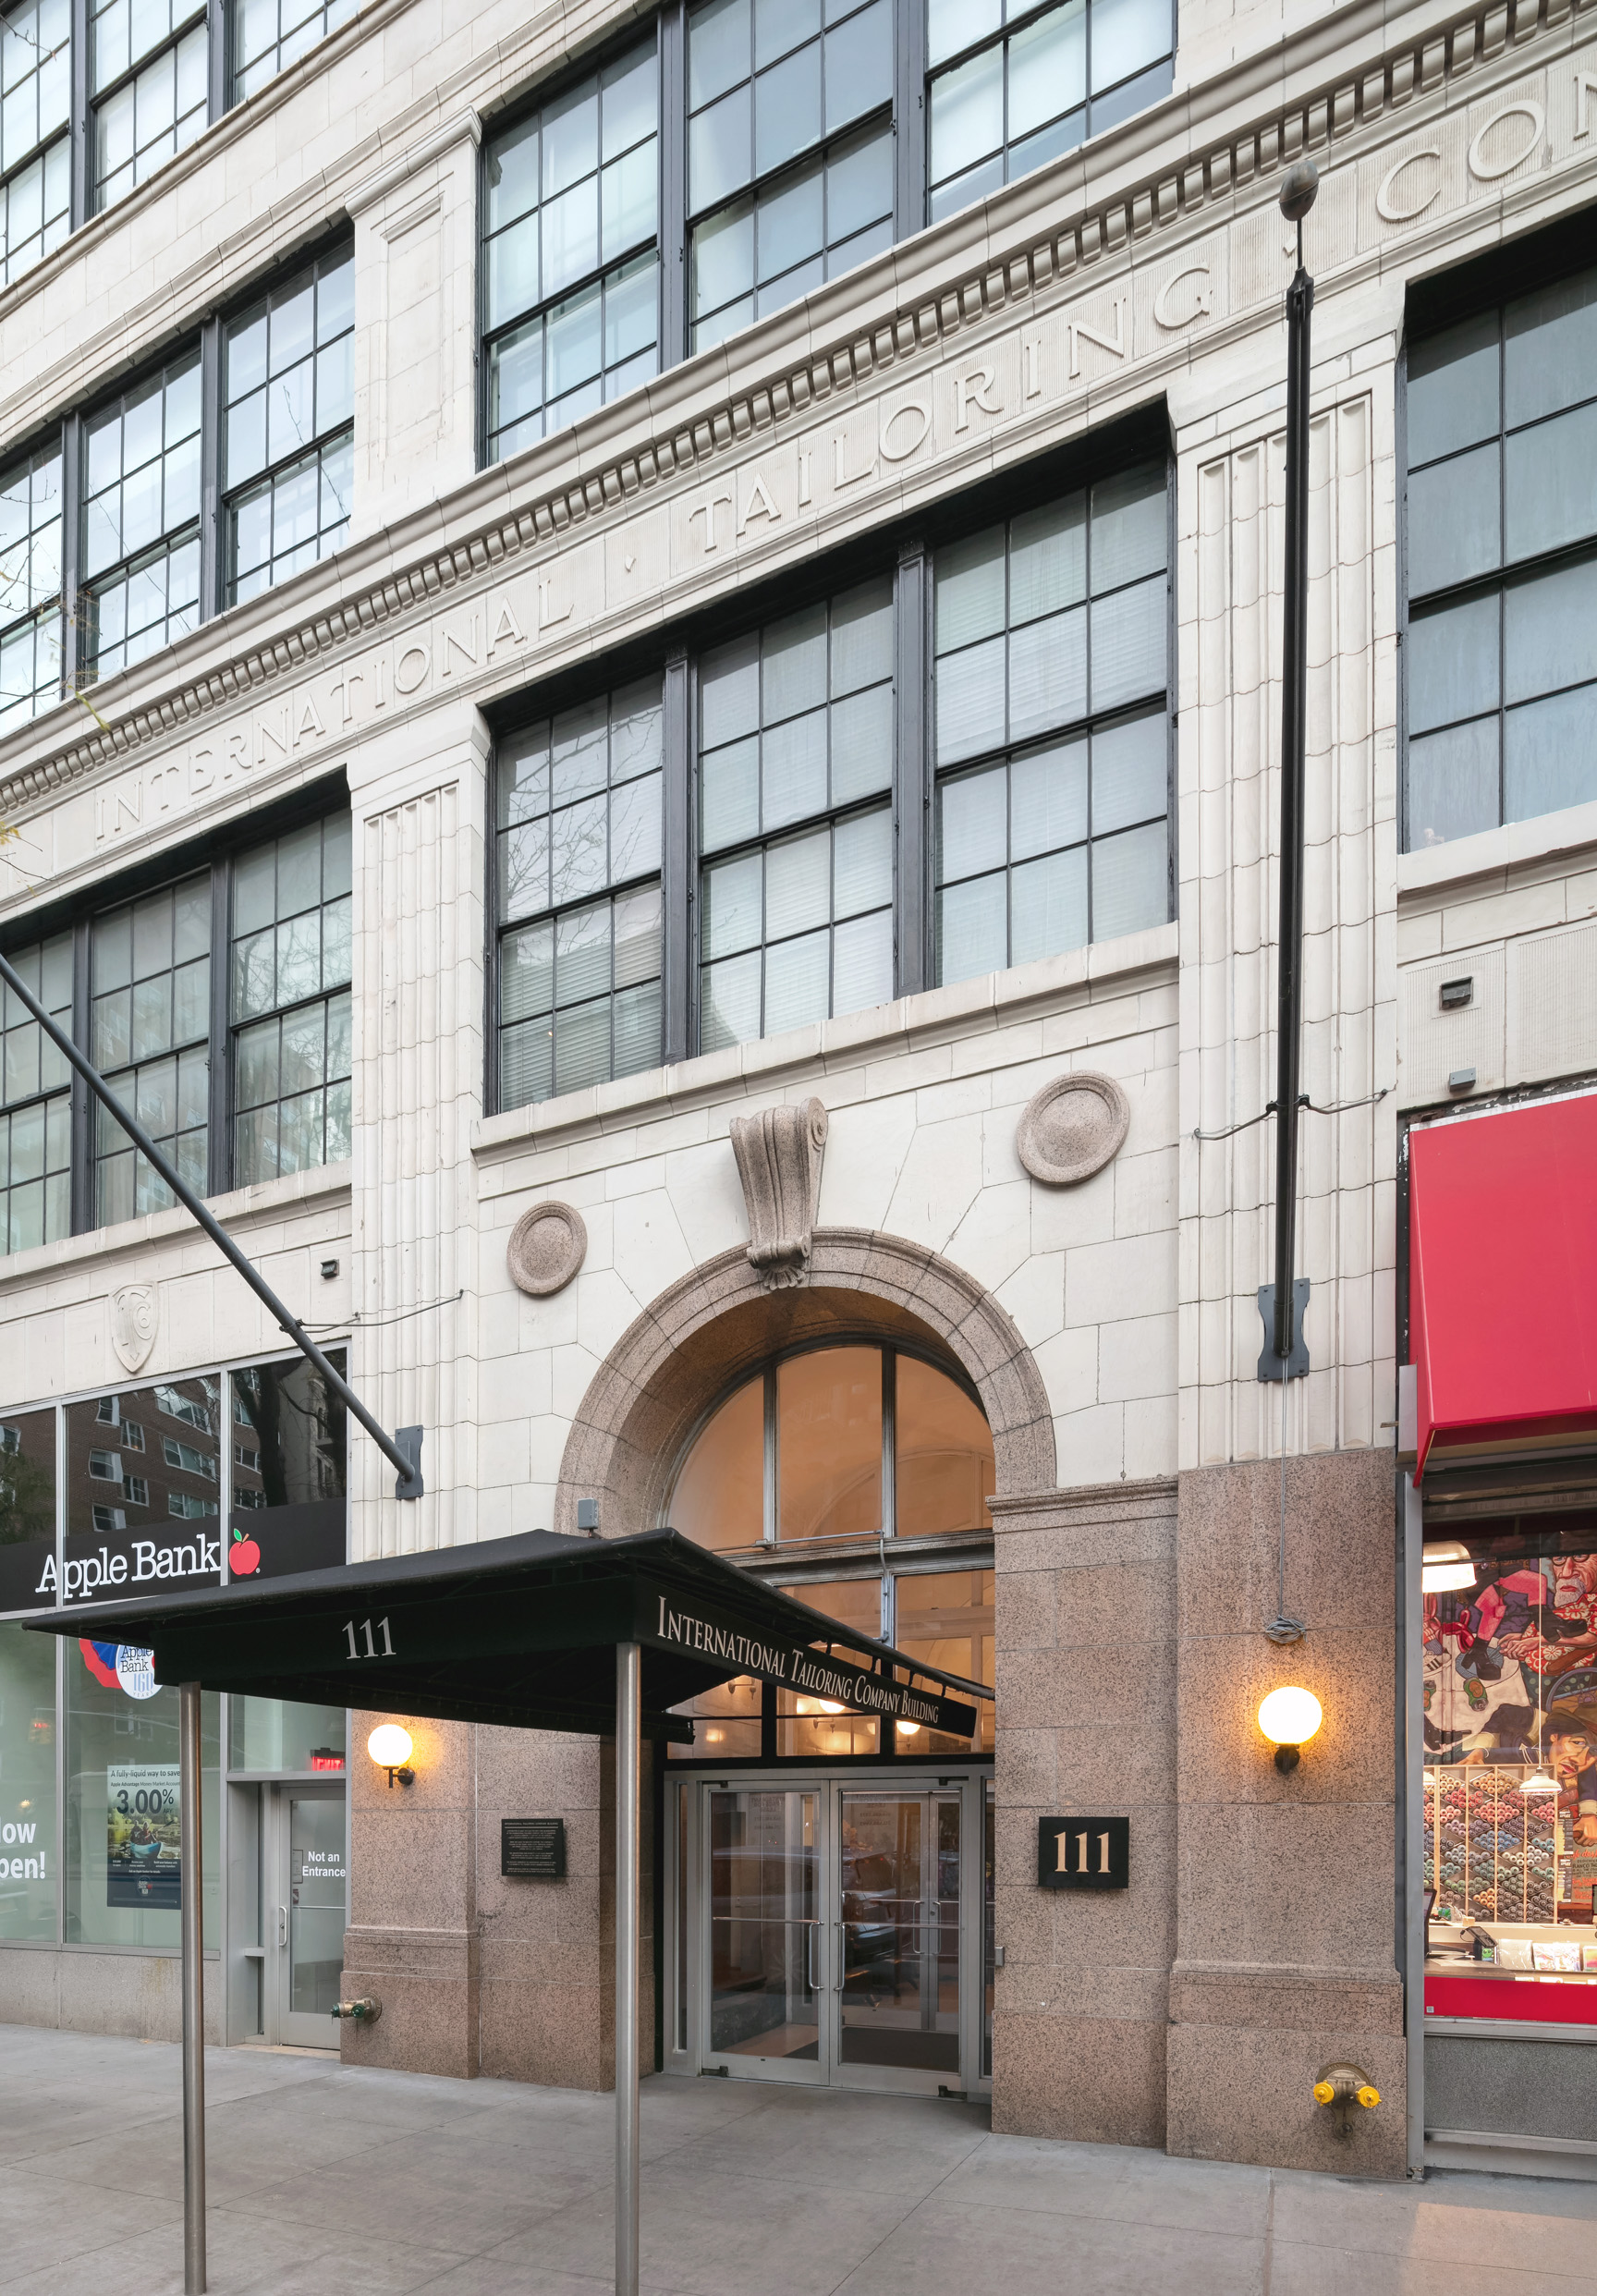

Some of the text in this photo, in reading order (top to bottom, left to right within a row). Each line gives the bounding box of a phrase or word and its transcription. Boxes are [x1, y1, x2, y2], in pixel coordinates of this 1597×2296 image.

[95, 578, 575, 840] INTERNATIONAL
[689, 260, 1213, 552] TAILORING
[35, 1533, 221, 1599] Apple Bank
[342, 1616, 396, 1659] 111
[120, 1645, 152, 1661] Apple
[120, 1658, 149, 1673] Bank
[133, 1672, 153, 1692] 160
[116, 1789, 174, 1814] 3.00%
[0, 1820, 36, 1844] ow
[308, 1850, 340, 1862] Not an
[1054, 1831, 1111, 1874] 111
[302, 1865, 346, 1877] Entrance
